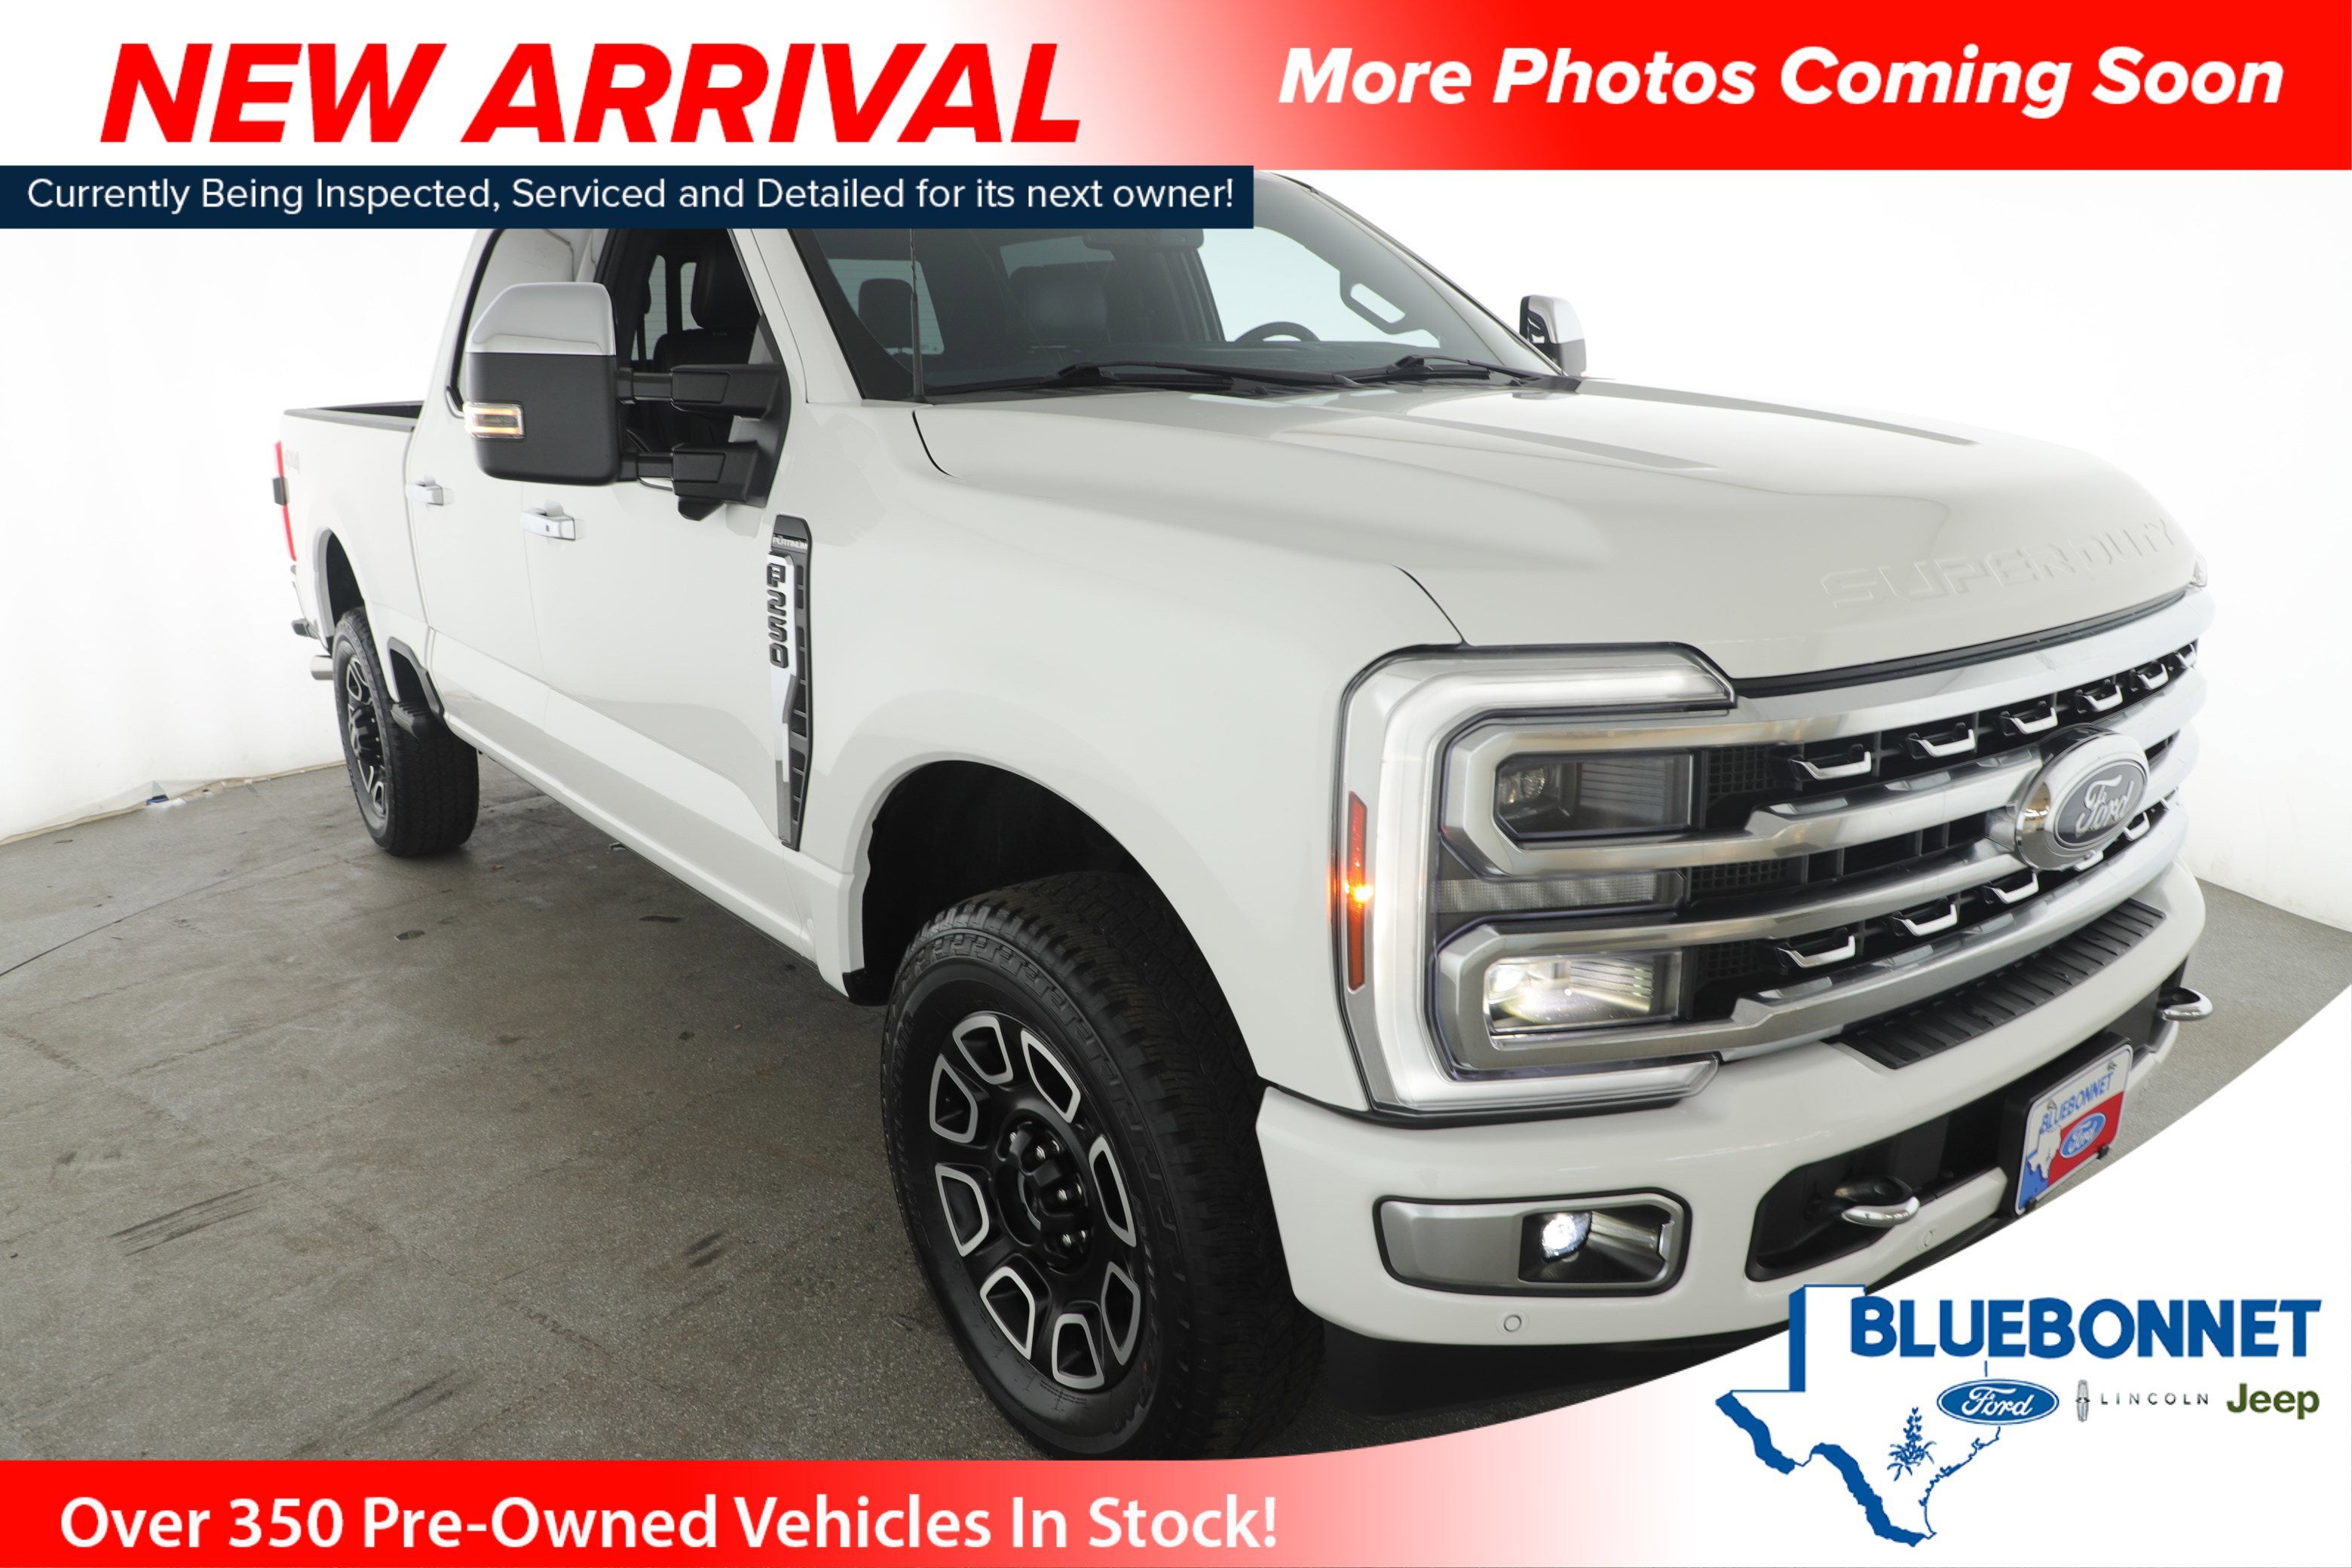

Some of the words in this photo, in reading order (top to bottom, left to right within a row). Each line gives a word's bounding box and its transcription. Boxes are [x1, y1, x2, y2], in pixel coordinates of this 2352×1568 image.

[1820, 543, 2076, 610] SUPER
[2075, 774, 2134, 838] Ford
[2039, 1070, 2115, 1135] BLUEBONNET
[2067, 1119, 2099, 1155] Ford
